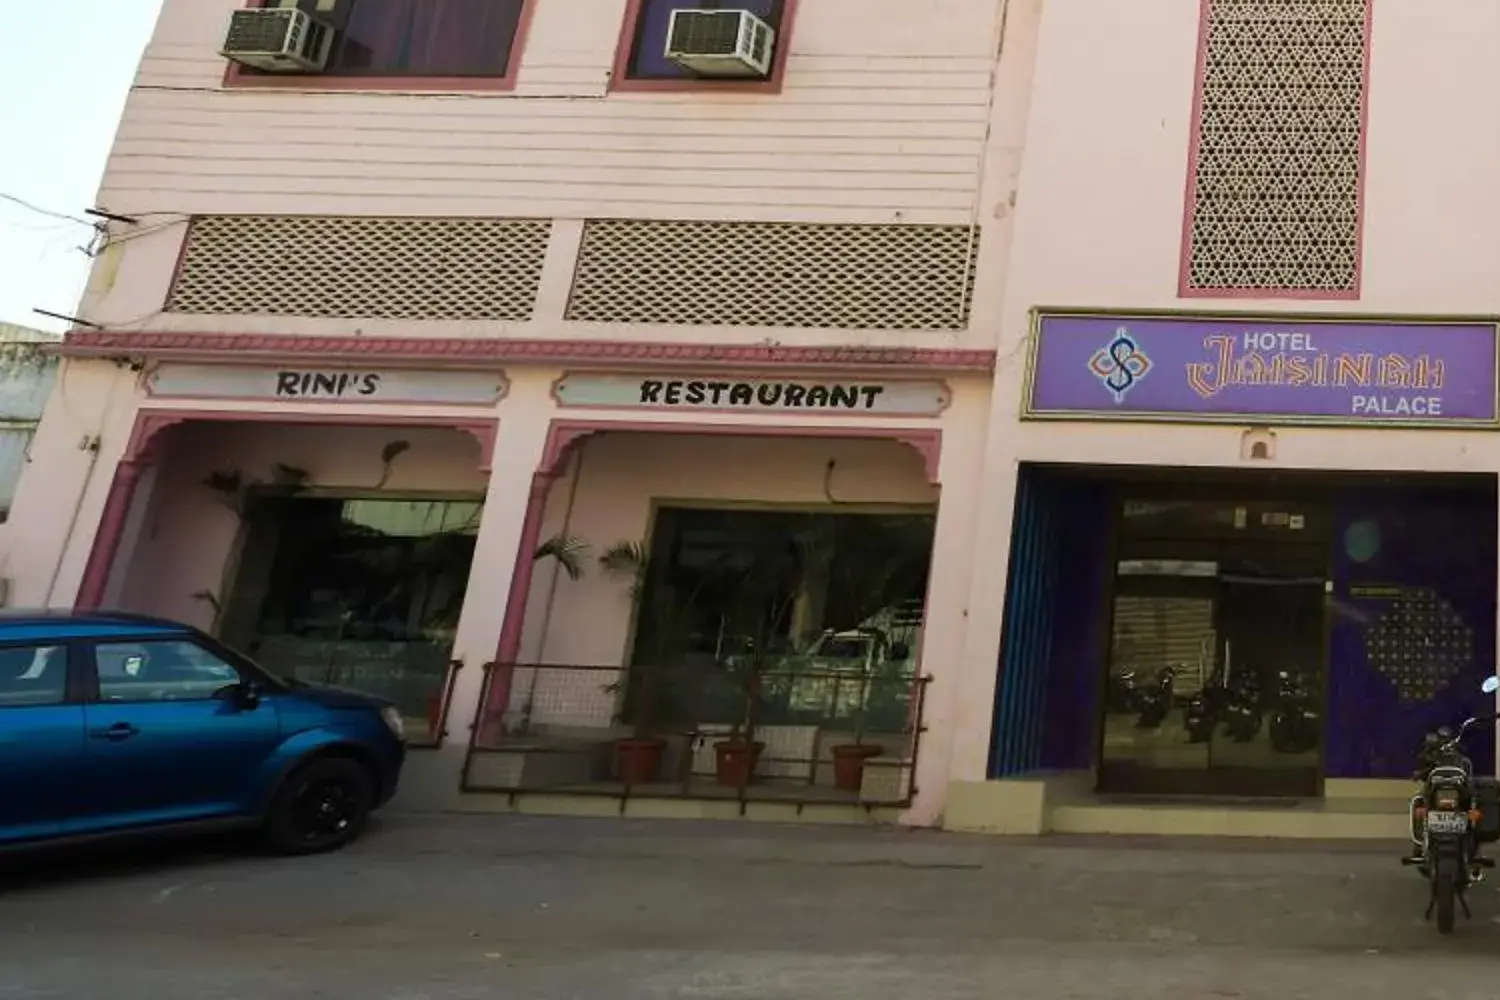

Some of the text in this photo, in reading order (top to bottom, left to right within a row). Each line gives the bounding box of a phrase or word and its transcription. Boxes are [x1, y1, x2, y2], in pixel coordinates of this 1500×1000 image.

[1243, 333, 1318, 351] HOTEL
[276, 372, 380, 396] RINI'S
[640, 380, 884, 408] RESTAURANT
[1352, 396, 1442, 415] PALACE
